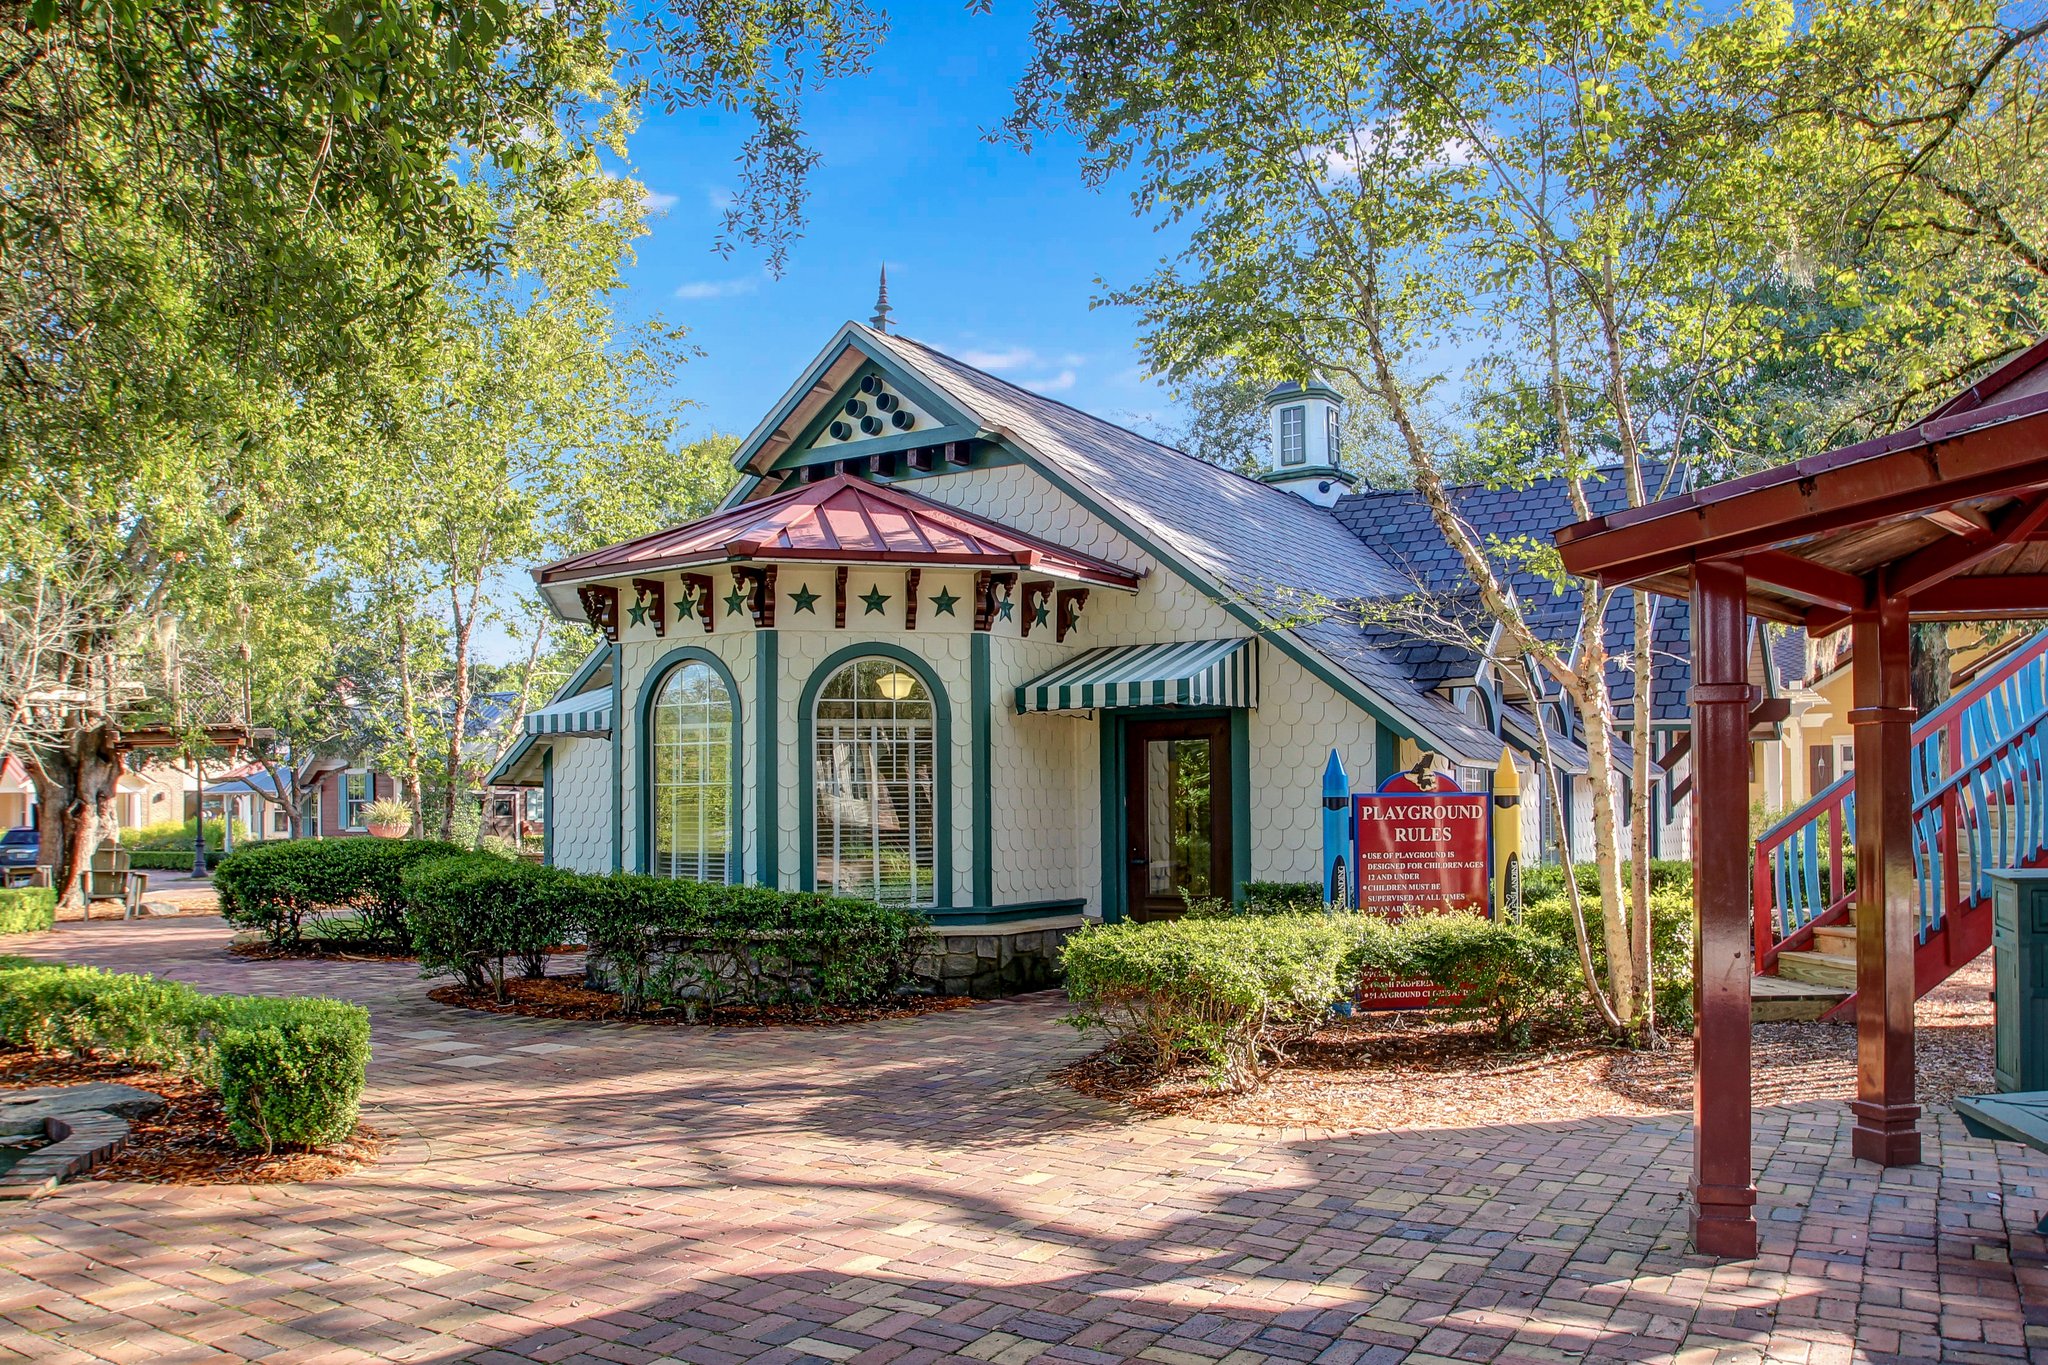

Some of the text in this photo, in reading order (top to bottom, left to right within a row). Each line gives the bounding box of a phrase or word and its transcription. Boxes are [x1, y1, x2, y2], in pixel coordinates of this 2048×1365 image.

[1362, 805, 1483, 820] PLAYGROUND
[1395, 827, 1452, 842] RULES
[1367, 852, 1382, 860] USE
[1367, 894, 1414, 902] SUPERVISED
